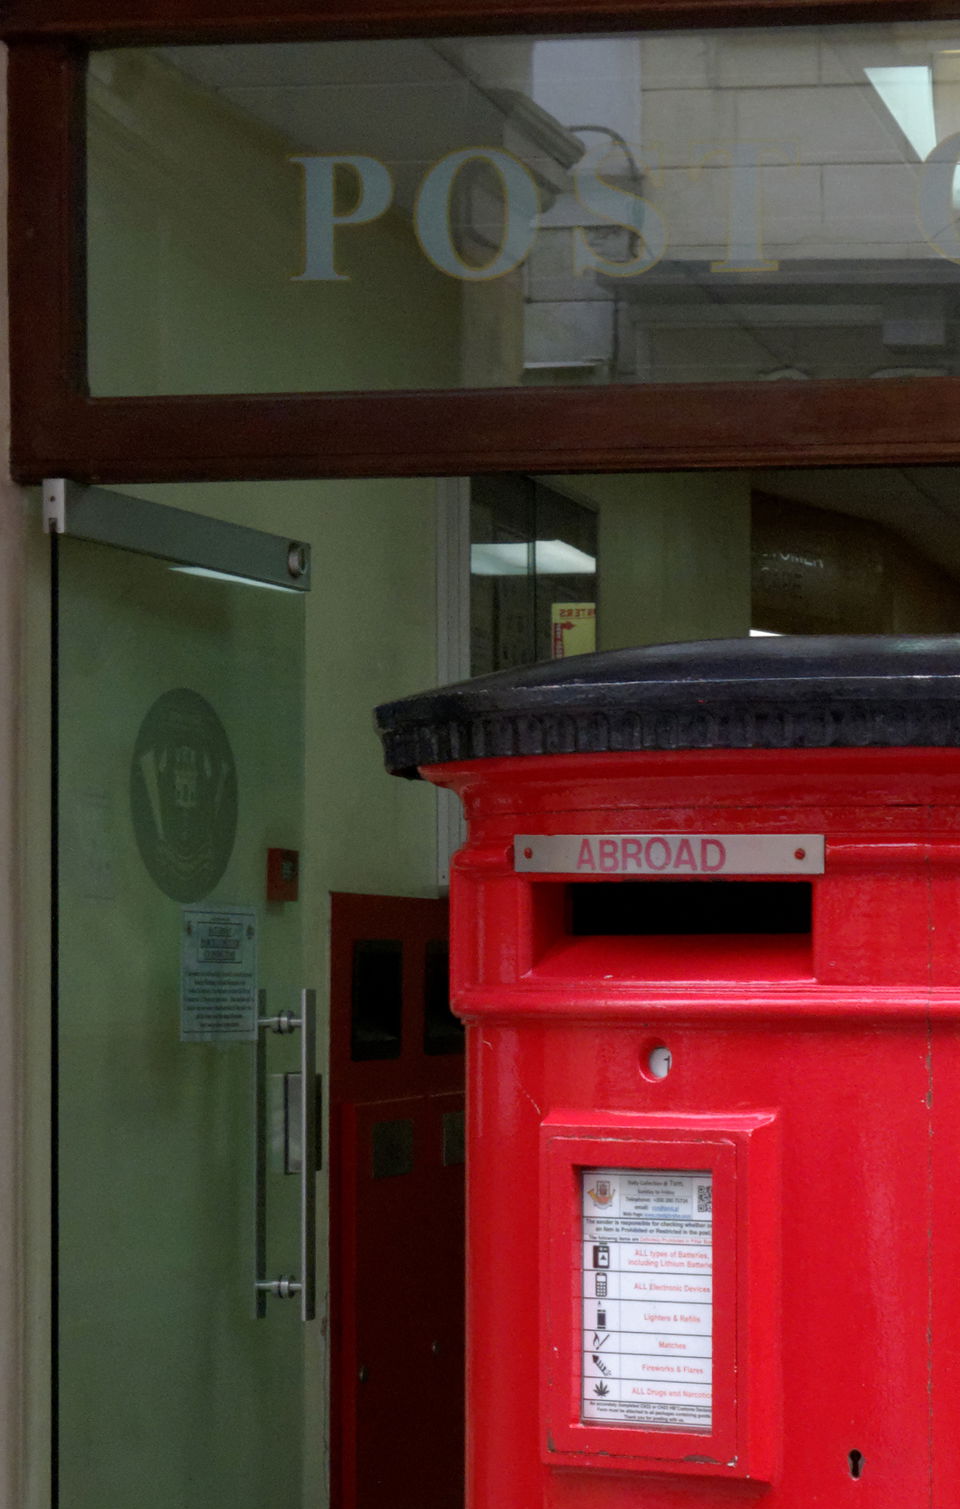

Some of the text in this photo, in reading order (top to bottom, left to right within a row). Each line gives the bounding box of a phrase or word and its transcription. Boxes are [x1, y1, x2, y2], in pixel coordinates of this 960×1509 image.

[288, 141, 802, 284] POST
[576, 837, 728, 873] ABROAD
[634, 1282, 647, 1290] ALL
[658, 1341, 686, 1349] Matches
[642, 1364, 674, 1373] Fireworks
